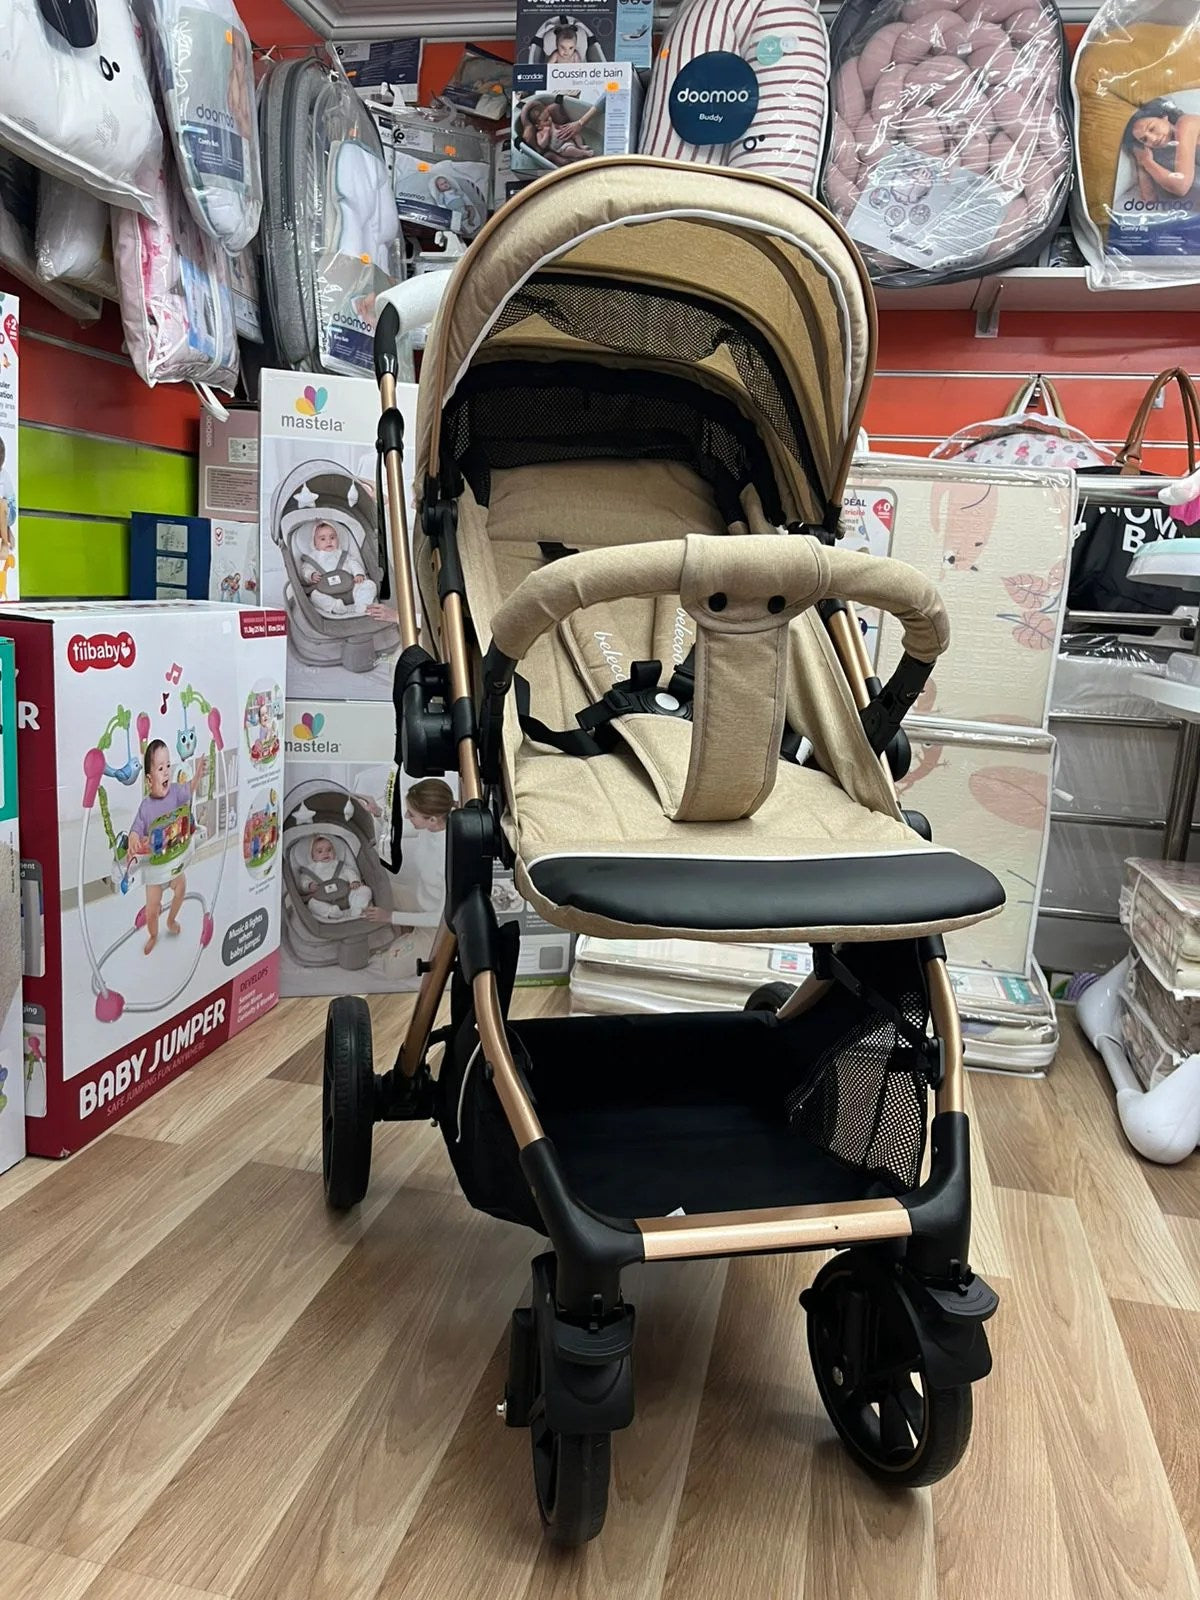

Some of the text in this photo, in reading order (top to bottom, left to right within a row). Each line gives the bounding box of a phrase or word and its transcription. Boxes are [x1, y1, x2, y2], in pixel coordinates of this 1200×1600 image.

[522, 72, 544, 80] candide
[551, 67, 623, 79] Coussin de bain
[677, 88, 749, 103] doomoo
[699, 113, 723, 123] Buddy
[1123, 198, 1194, 211] doomoo
[333, 312, 372, 332] doomoo
[281, 415, 343, 432] mastela
[876, 502, 890, 512] +0
[73, 640, 120, 662] tiibaby
[228, 926, 244, 941] Music
[249, 913, 264, 930] lights
[238, 930, 253, 945] when
[230, 946, 243, 961] baby
[240, 966, 269, 993] DEVELOPS
[80, 997, 226, 1120] BABY JUMPER
[106, 1039, 207, 1117] SAFE JUMPING FUN ANYWHERE
